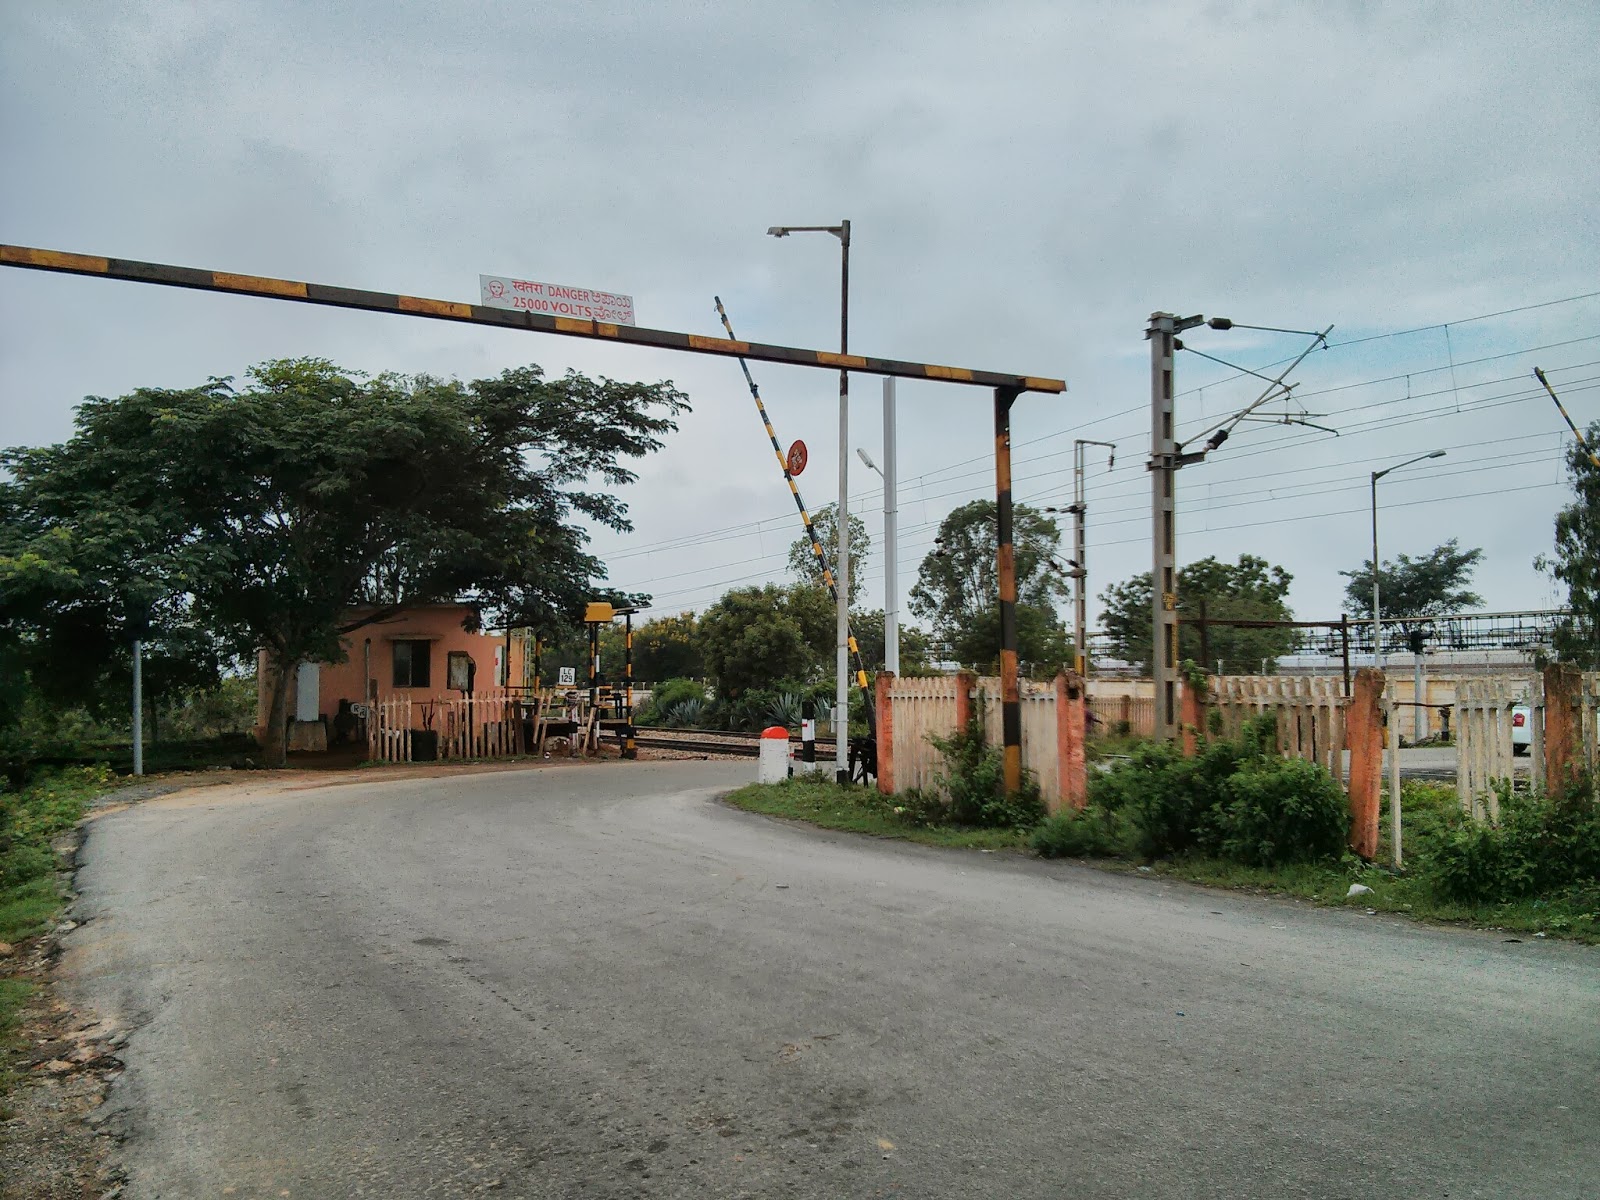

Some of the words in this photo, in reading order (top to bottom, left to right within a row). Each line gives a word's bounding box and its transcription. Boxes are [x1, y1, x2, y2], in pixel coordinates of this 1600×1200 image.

[512, 281, 543, 294] खतरा
[548, 286, 590, 302] DANGER
[592, 292, 630, 308] ಅಪಾಯ
[513, 296, 548, 311] 25000
[550, 301, 592, 317] VOLTS
